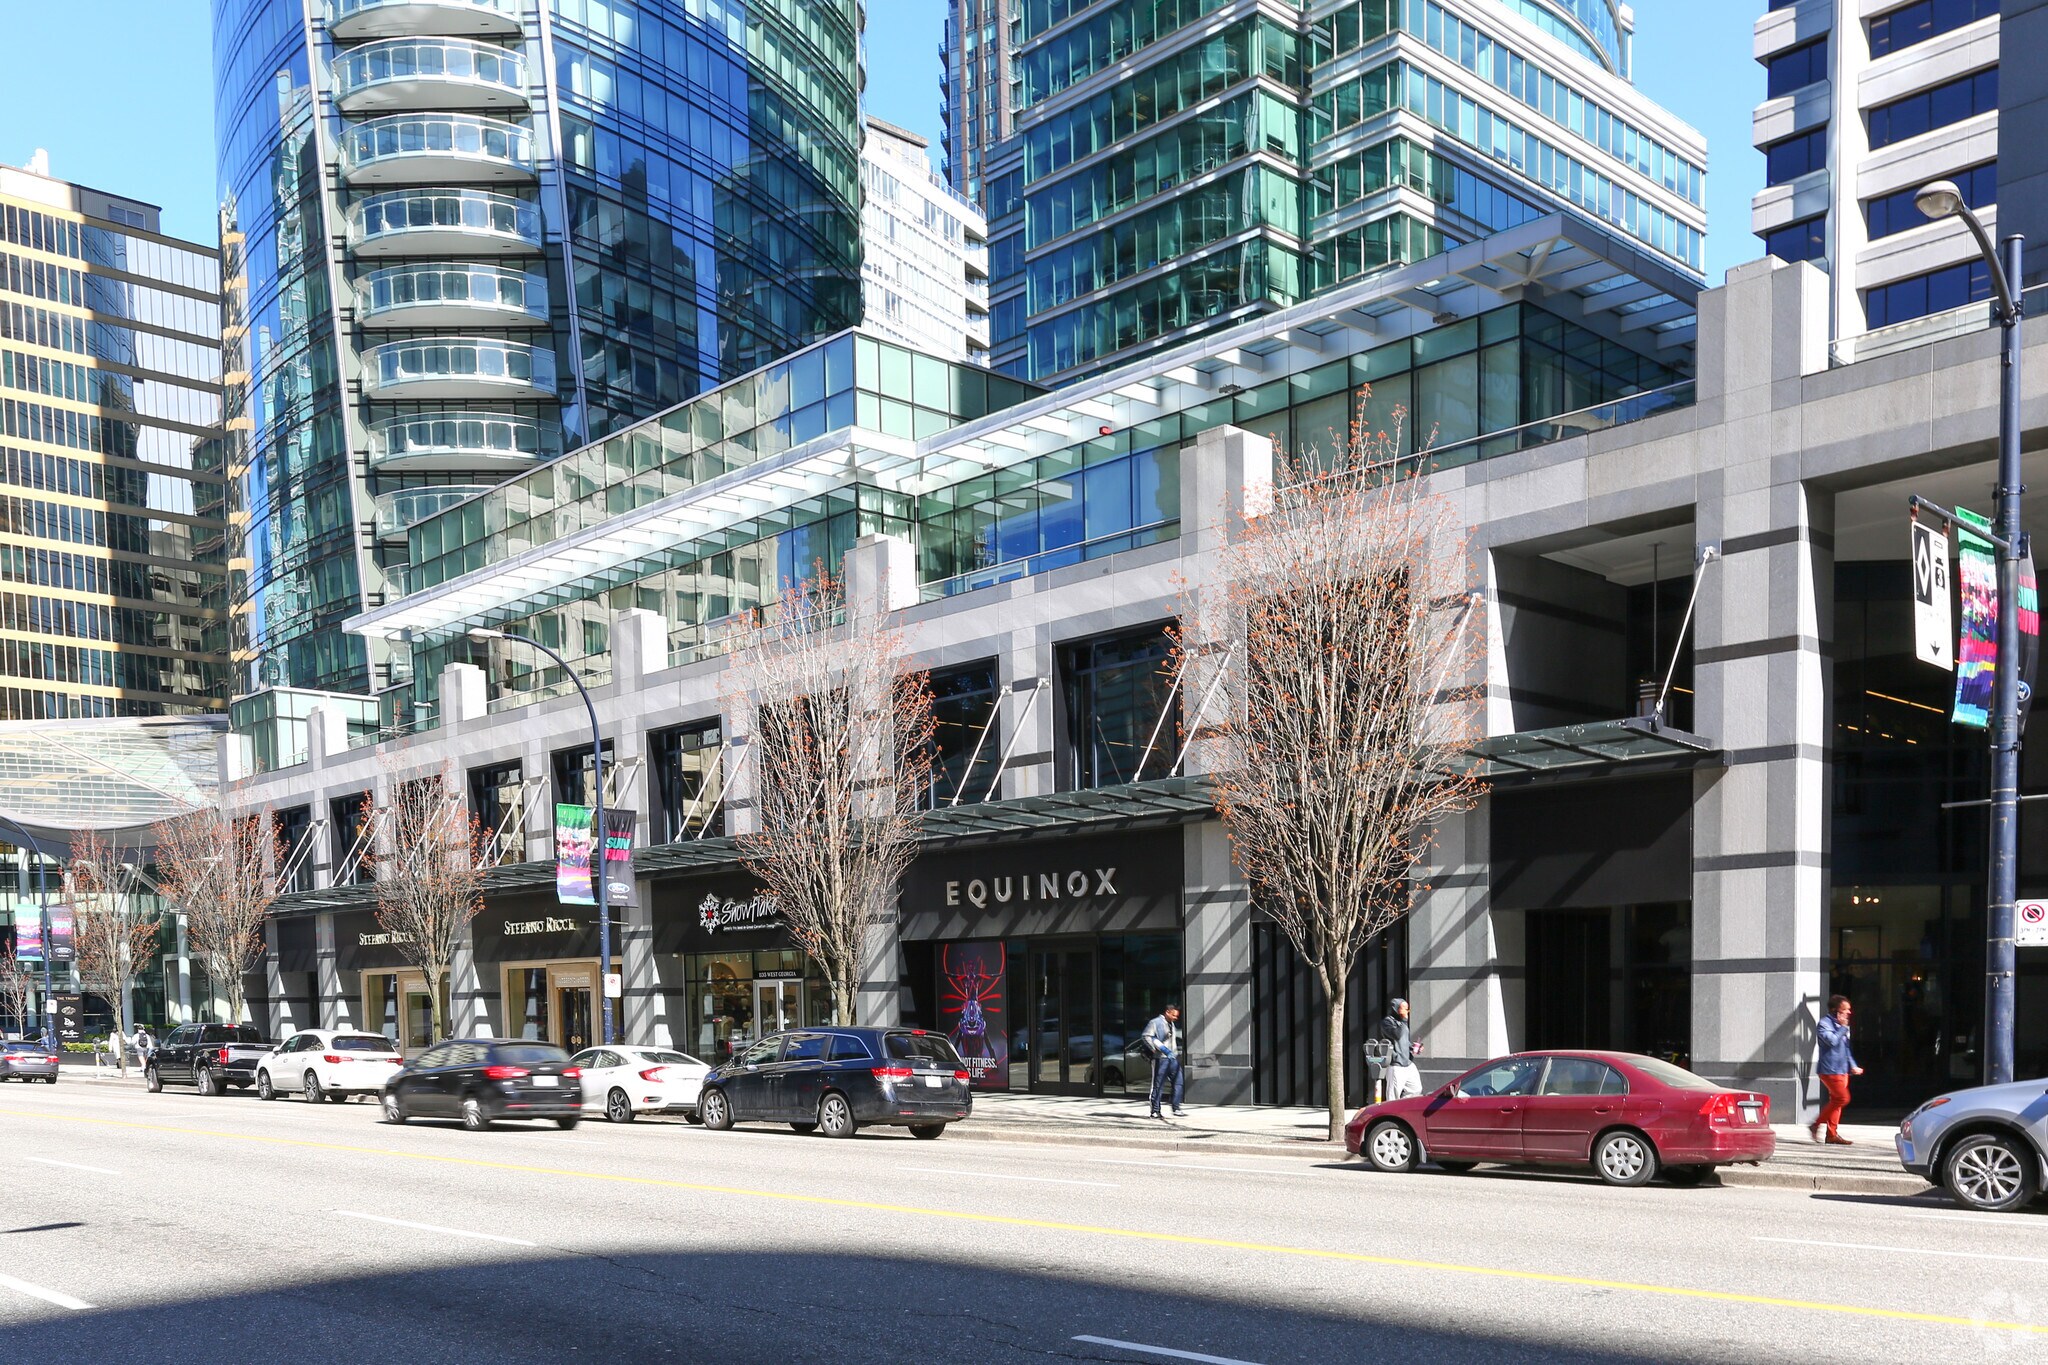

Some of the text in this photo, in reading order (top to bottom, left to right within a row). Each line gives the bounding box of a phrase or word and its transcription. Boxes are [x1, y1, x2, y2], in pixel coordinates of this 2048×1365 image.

[605, 837, 631, 850] SUN
[947, 867, 1118, 909] EQUINOX
[972, 1057, 998, 1069] FITNESS.
[972, 1068, 986, 1079] LIFE.
